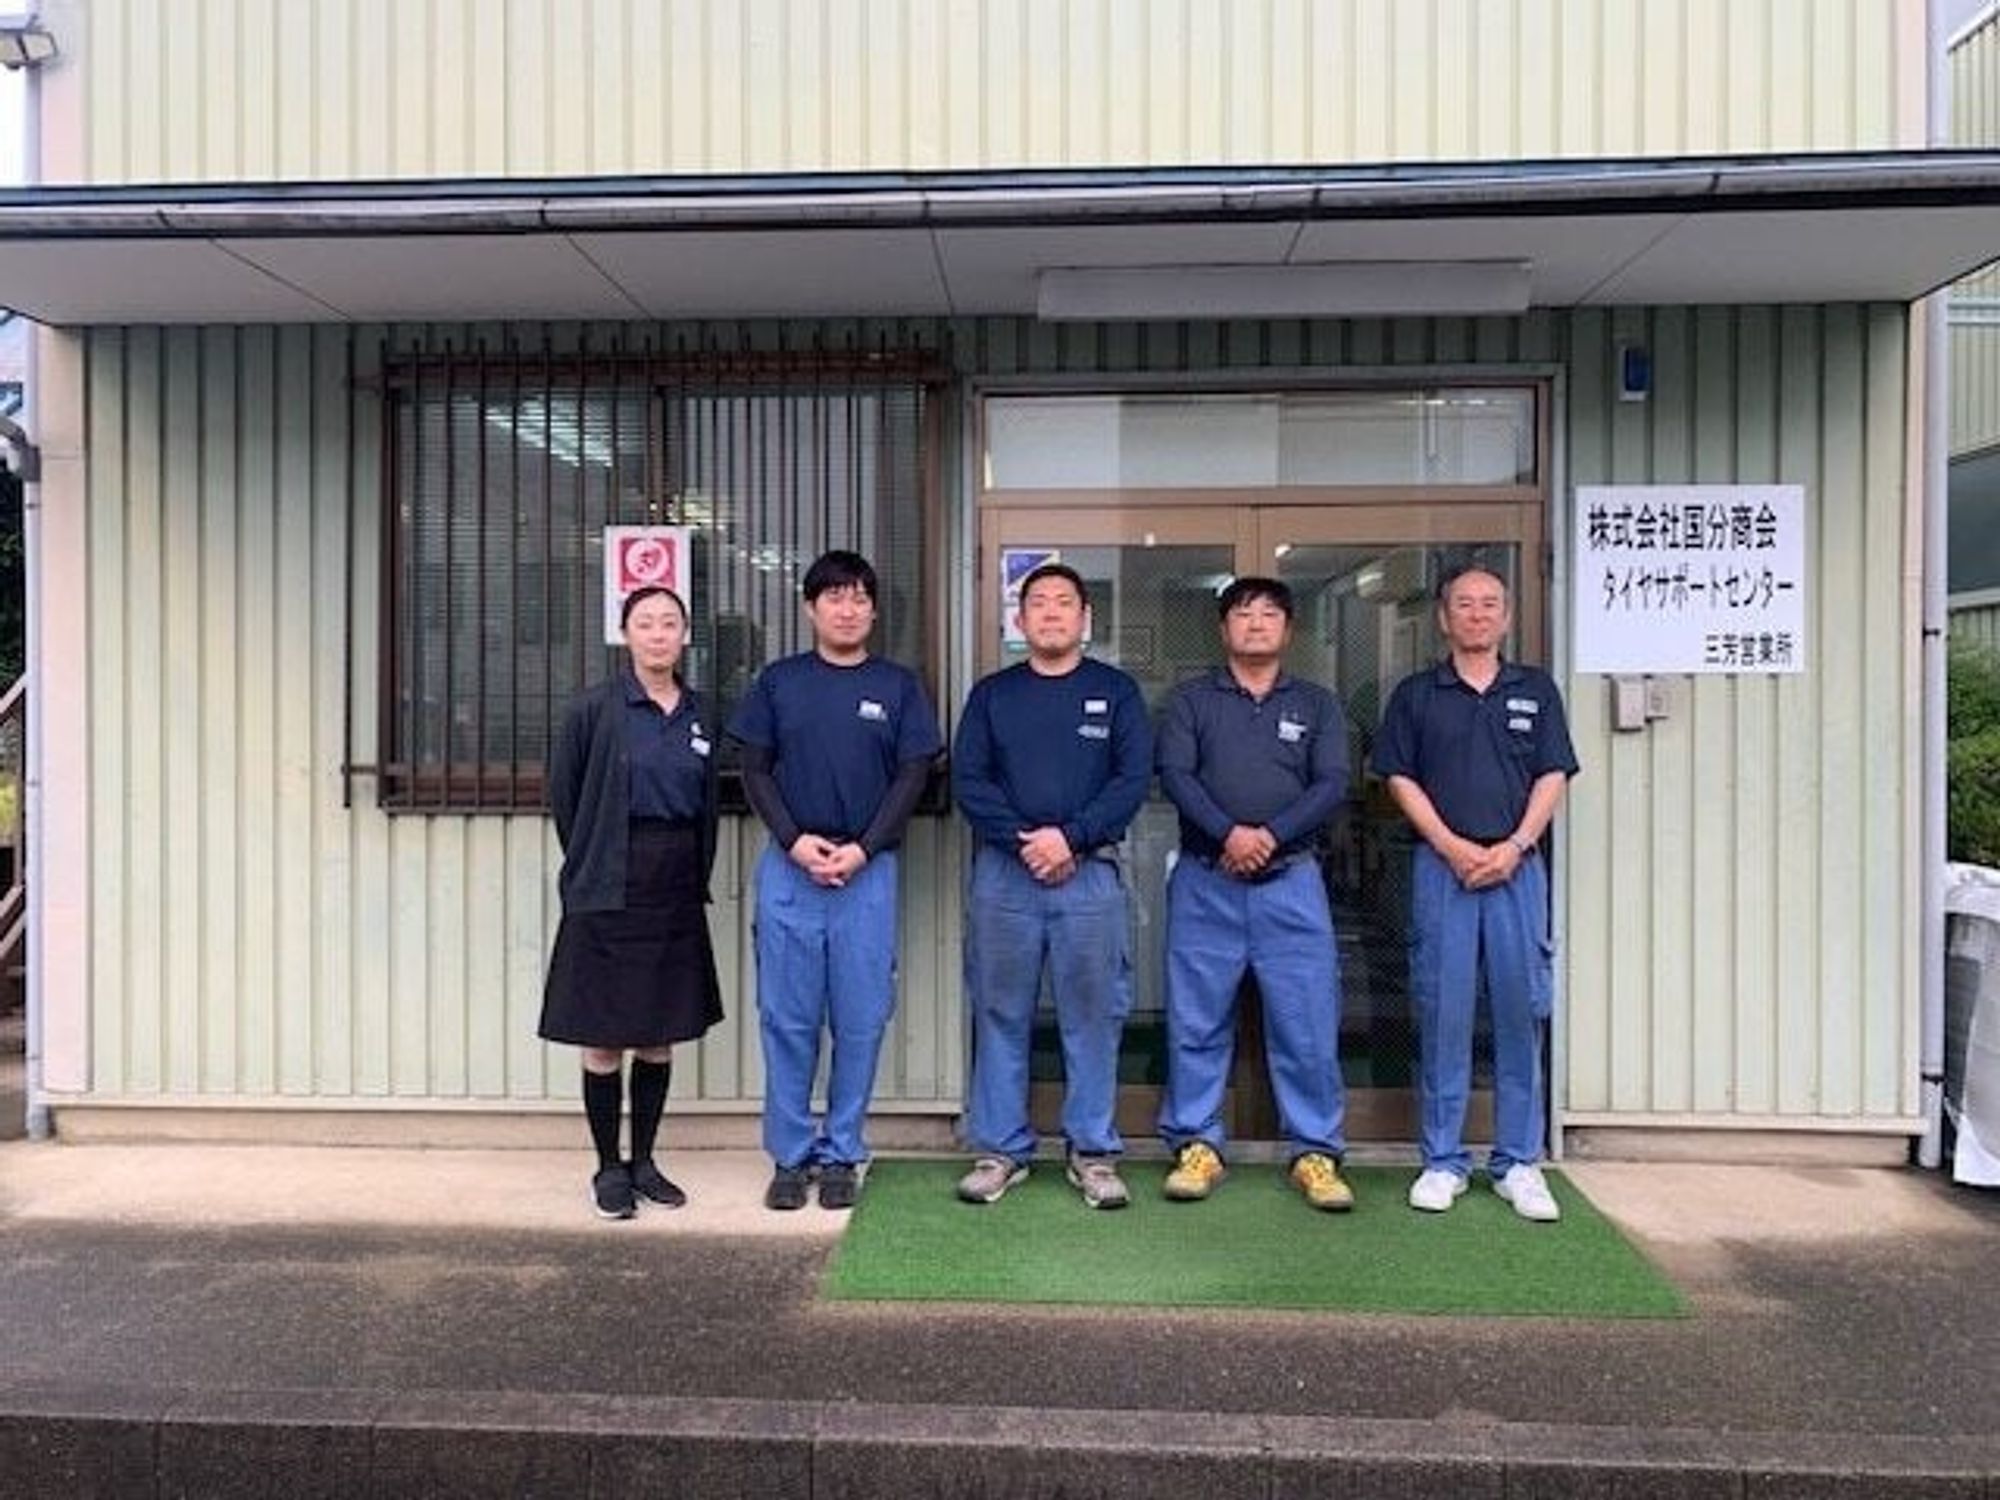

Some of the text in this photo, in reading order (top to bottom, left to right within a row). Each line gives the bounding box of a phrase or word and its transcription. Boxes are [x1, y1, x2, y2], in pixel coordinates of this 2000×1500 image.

[1588, 502, 1776, 550] 株式会社国分商会
[1603, 562, 1793, 610] タイヤサポートセンター
[1705, 631, 1792, 666] 三芳営業所
